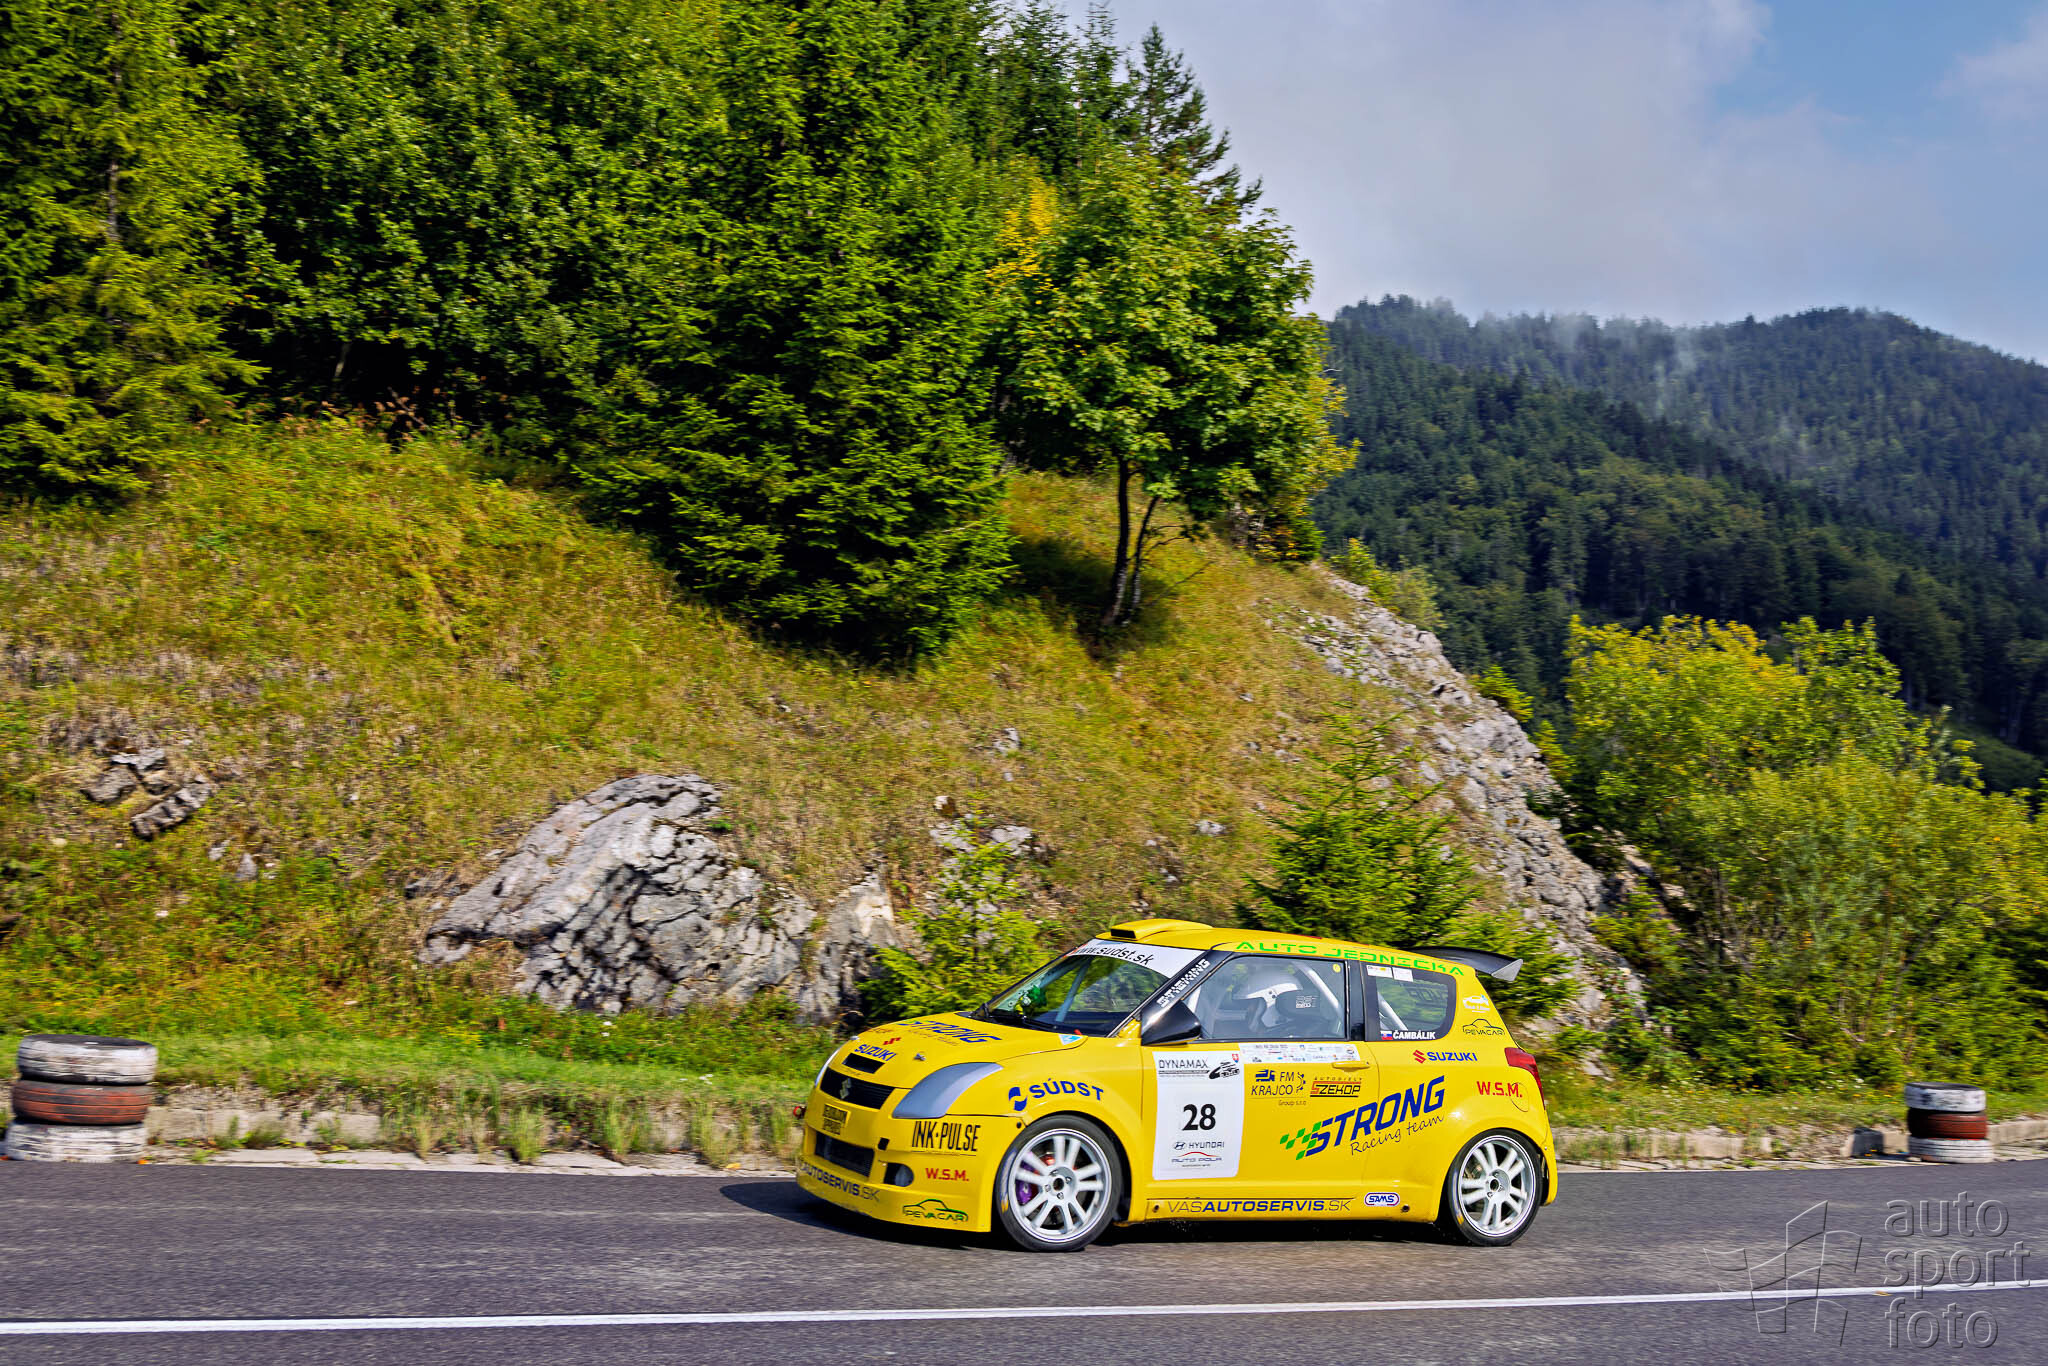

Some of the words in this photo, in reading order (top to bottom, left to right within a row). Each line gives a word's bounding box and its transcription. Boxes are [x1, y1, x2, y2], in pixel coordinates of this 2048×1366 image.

[1236, 942, 1317, 954] AUTO
[1392, 1029, 1436, 1040] ČAMBÁLIK
[855, 1044, 897, 1062] SUZUKI
[1426, 1051, 1478, 1062] SUZUKI
[1158, 1060, 1208, 1069] DYNAMAX
[1279, 1071, 1294, 1082] FM
[1250, 1084, 1294, 1096] KRAJCO
[1476, 1080, 1524, 1099] W.S.M.
[1182, 1103, 1217, 1131] 28
[1305, 1075, 1445, 1157] STRONG
[1350, 1128, 1402, 1155] Racing
[1406, 1113, 1445, 1136] team
[1188, 1141, 1225, 1149] HYUNDAI
[925, 1167, 970, 1182] W.S.M.
[1368, 1194, 1395, 1203] SAMS
